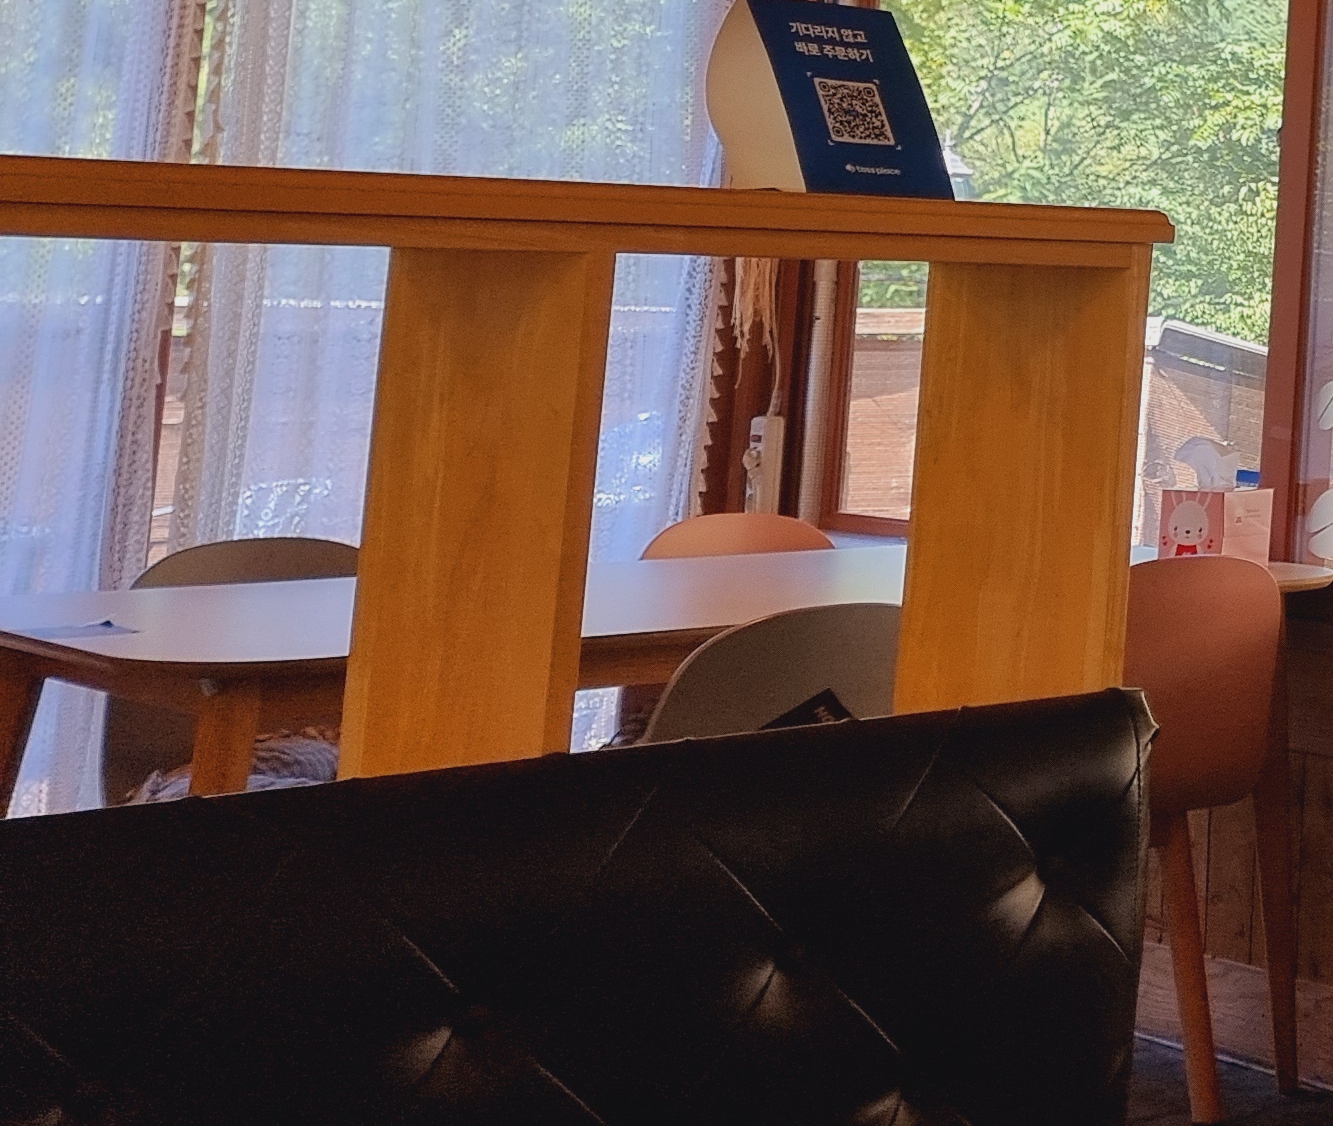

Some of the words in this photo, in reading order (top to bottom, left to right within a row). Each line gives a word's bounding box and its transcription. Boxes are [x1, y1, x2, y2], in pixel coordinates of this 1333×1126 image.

[788, 21, 841, 42] 기다리지
[840, 28, 868, 44] 않고
[794, 41, 822, 56] 바로
[822, 44, 874, 63] 주문하기
